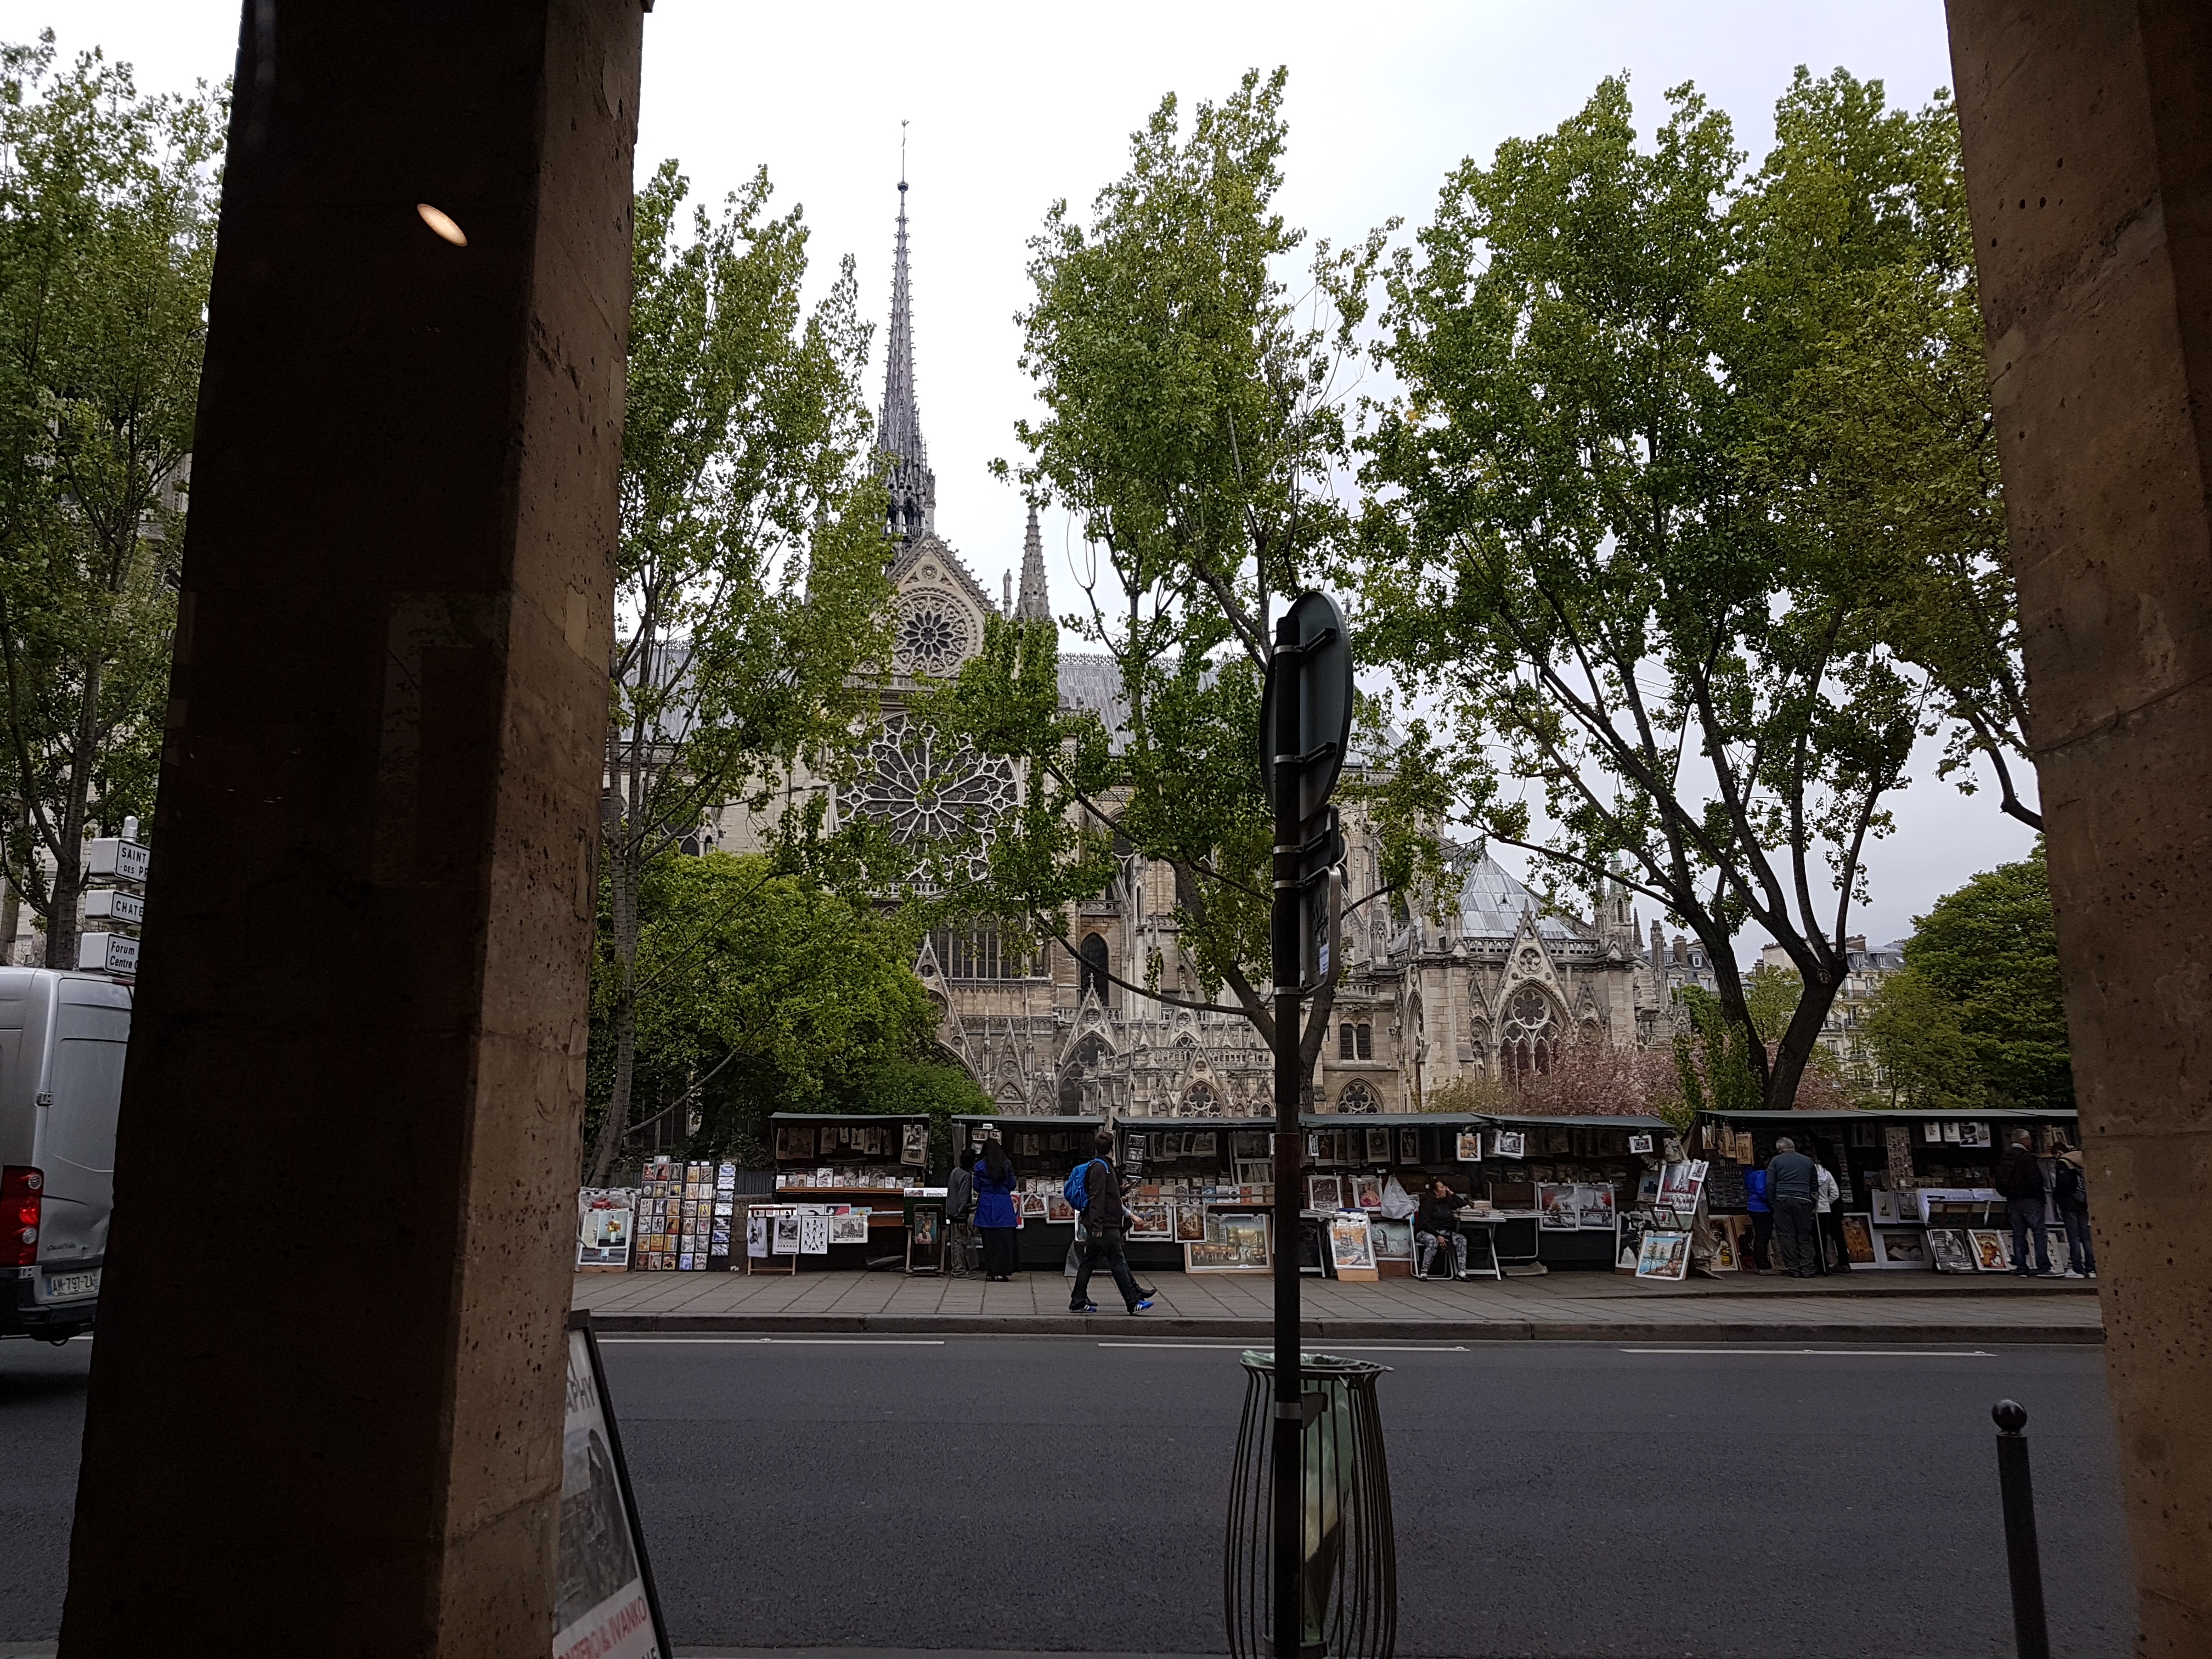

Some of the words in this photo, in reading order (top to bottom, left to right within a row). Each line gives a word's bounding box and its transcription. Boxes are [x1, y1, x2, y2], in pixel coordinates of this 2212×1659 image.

[121, 847, 146, 864] SAINT
[116, 900, 144, 917] CHATE
[111, 941, 135, 955] Forum
[110, 955, 132, 969] Centre
